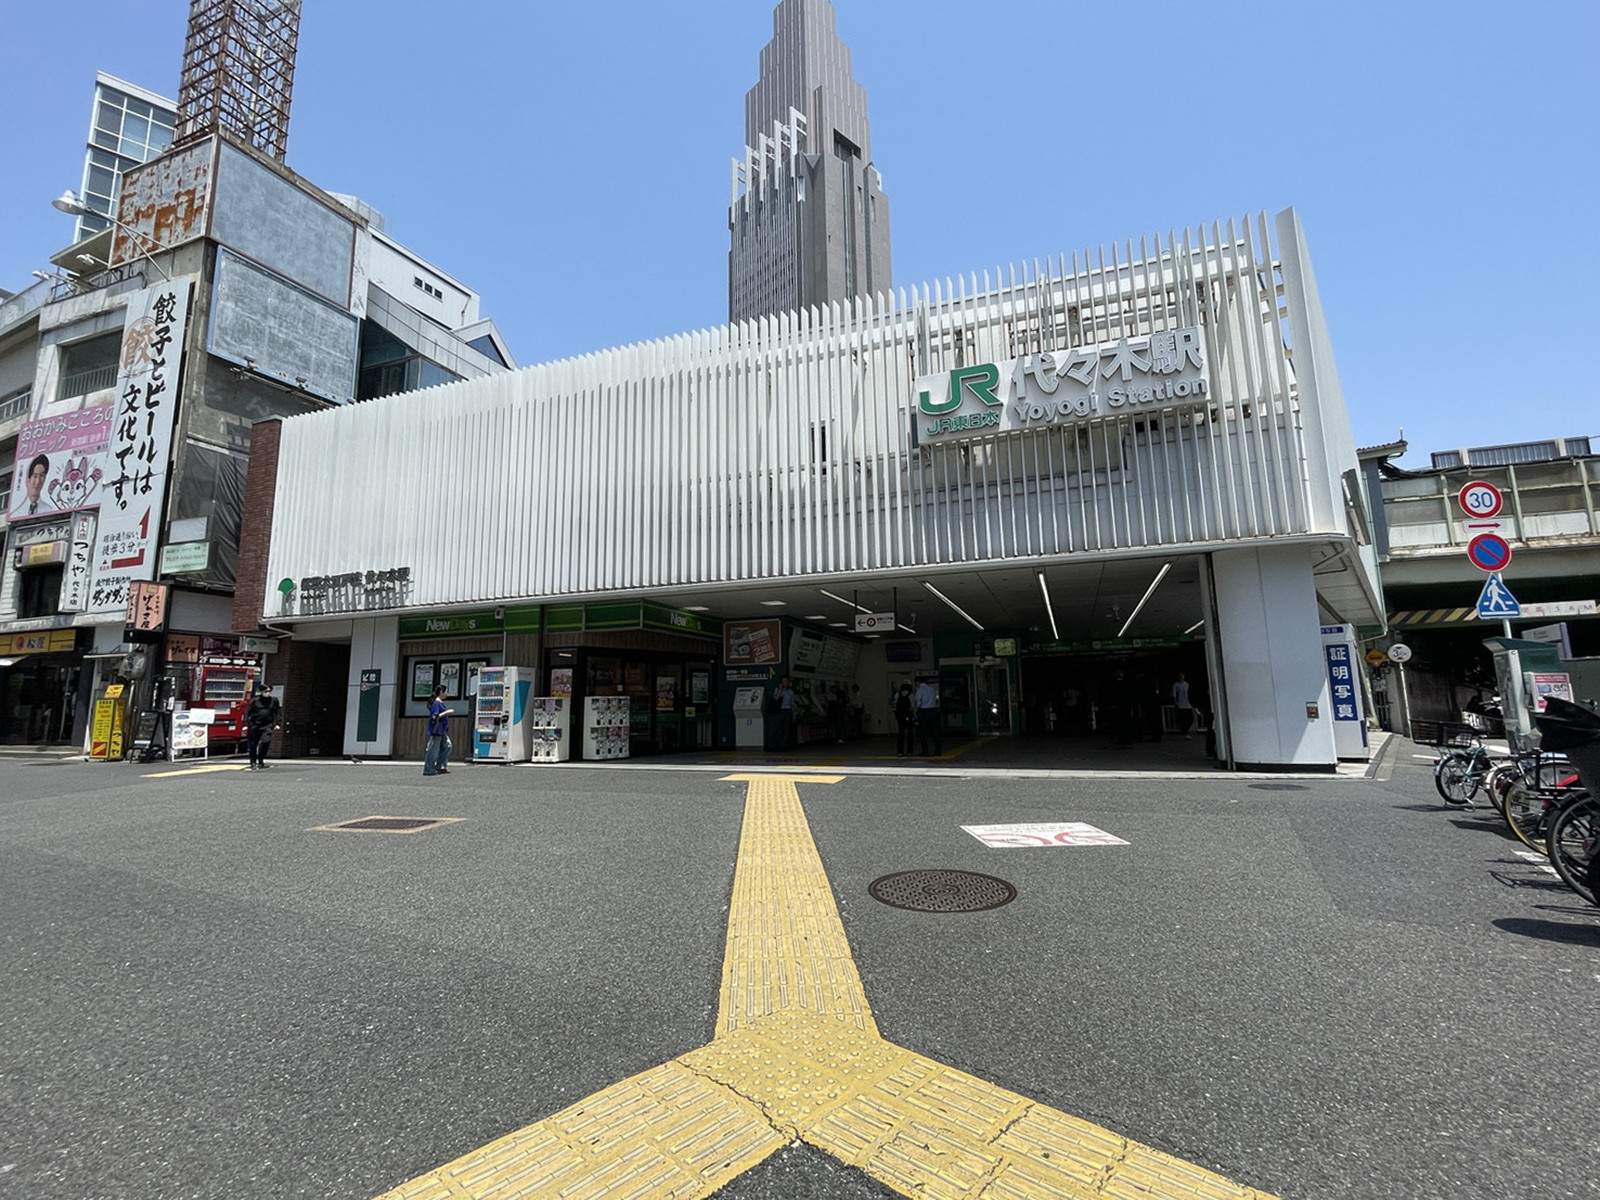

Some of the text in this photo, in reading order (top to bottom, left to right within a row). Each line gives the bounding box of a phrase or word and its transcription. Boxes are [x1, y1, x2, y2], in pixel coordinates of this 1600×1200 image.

[1012, 326, 1204, 399] 代々木駅
[133, 292, 176, 495] 餃子とビールは
[919, 363, 1003, 415] JR
[1014, 376, 1208, 422] Yoyogi Station
[21, 406, 114, 441] おおかみこころの
[111, 384, 142, 510] 文化です。
[926, 410, 1000, 435] JR東日本
[1469, 491, 1494, 509] 30
[71, 541, 89, 578] つちや
[1329, 646, 1354, 718] 証明写真
